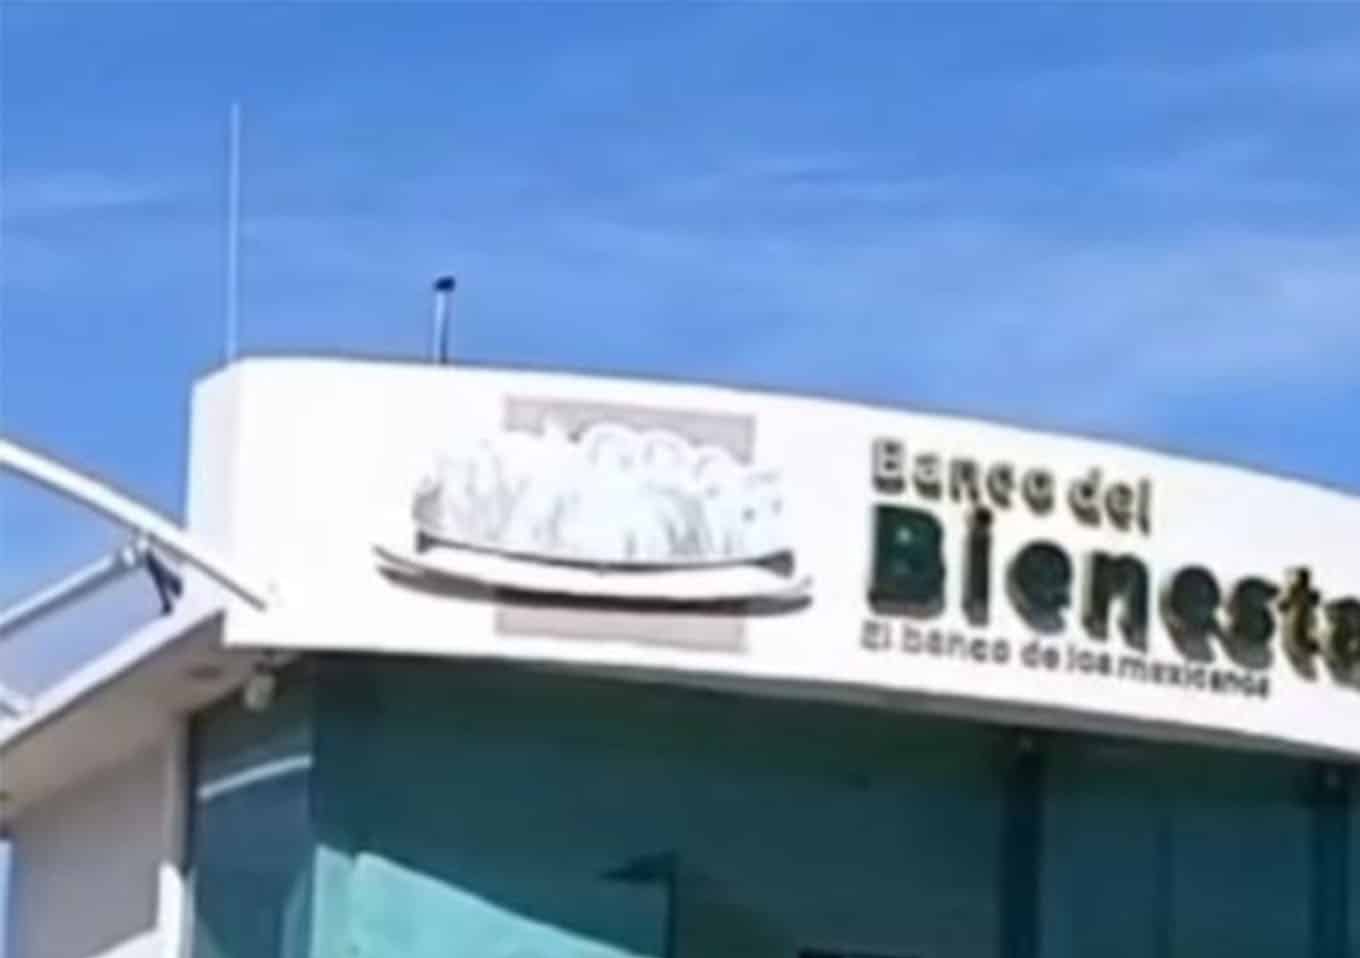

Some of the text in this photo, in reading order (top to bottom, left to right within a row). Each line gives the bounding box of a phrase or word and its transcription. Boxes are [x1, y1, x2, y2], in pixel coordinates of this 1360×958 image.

[871, 438, 1152, 537] Banco del
[860, 620, 1271, 699] El banco de los mexicanos
